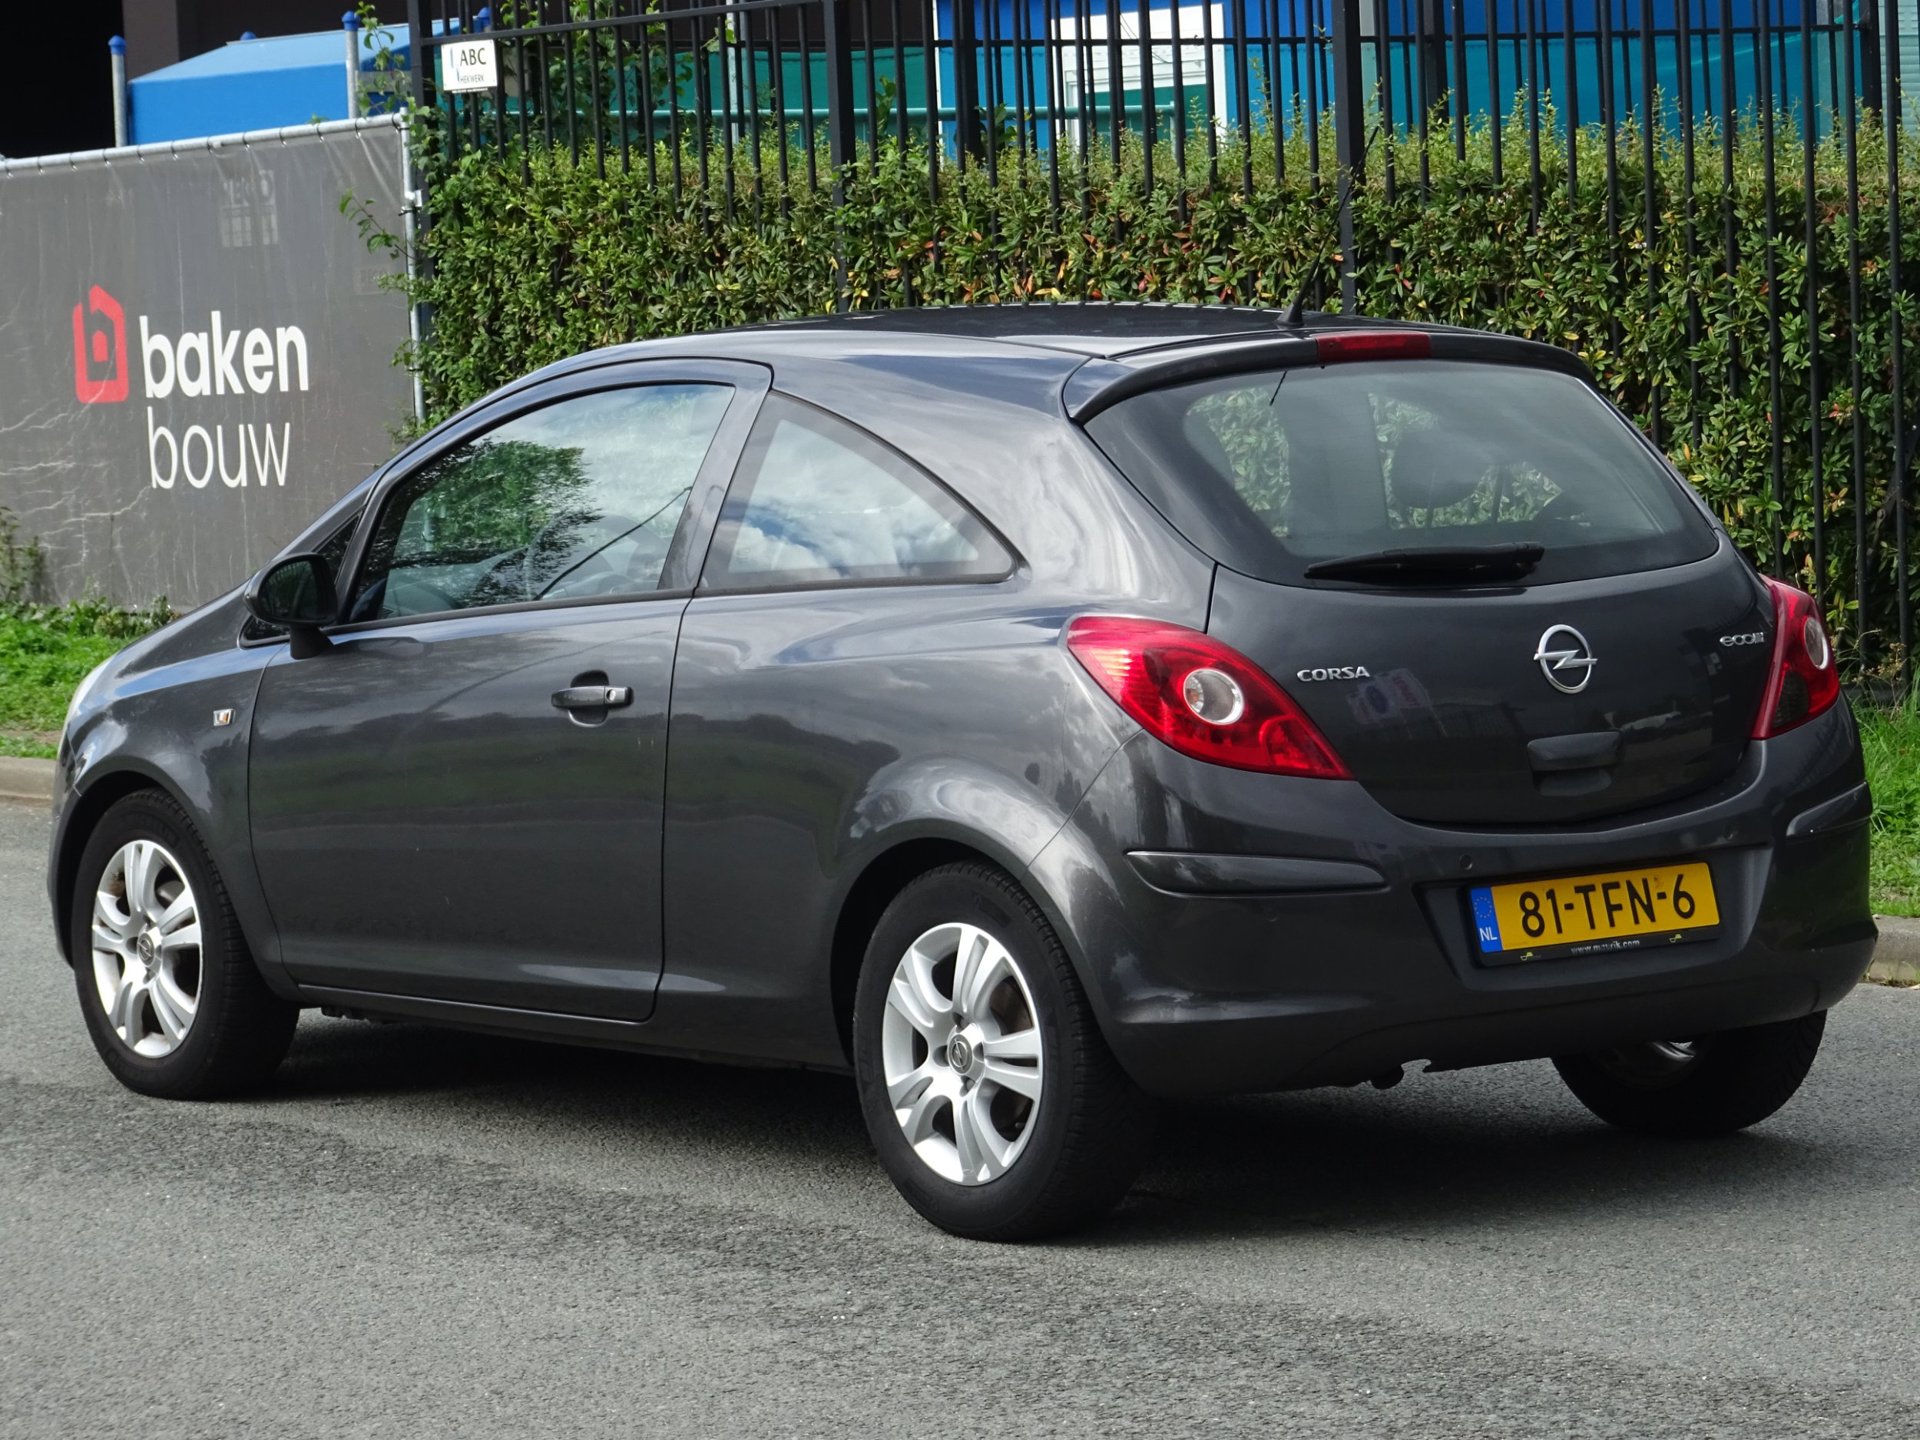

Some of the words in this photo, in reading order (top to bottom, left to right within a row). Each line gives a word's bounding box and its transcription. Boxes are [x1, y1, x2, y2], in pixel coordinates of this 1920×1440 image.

[460, 47, 487, 66] ABC
[139, 311, 309, 398] baken
[147, 406, 290, 489] bouw
[1296, 666, 1370, 682] CORSA
[1519, 874, 1696, 938] 81-TFN-6
[1479, 927, 1498, 942] NL
